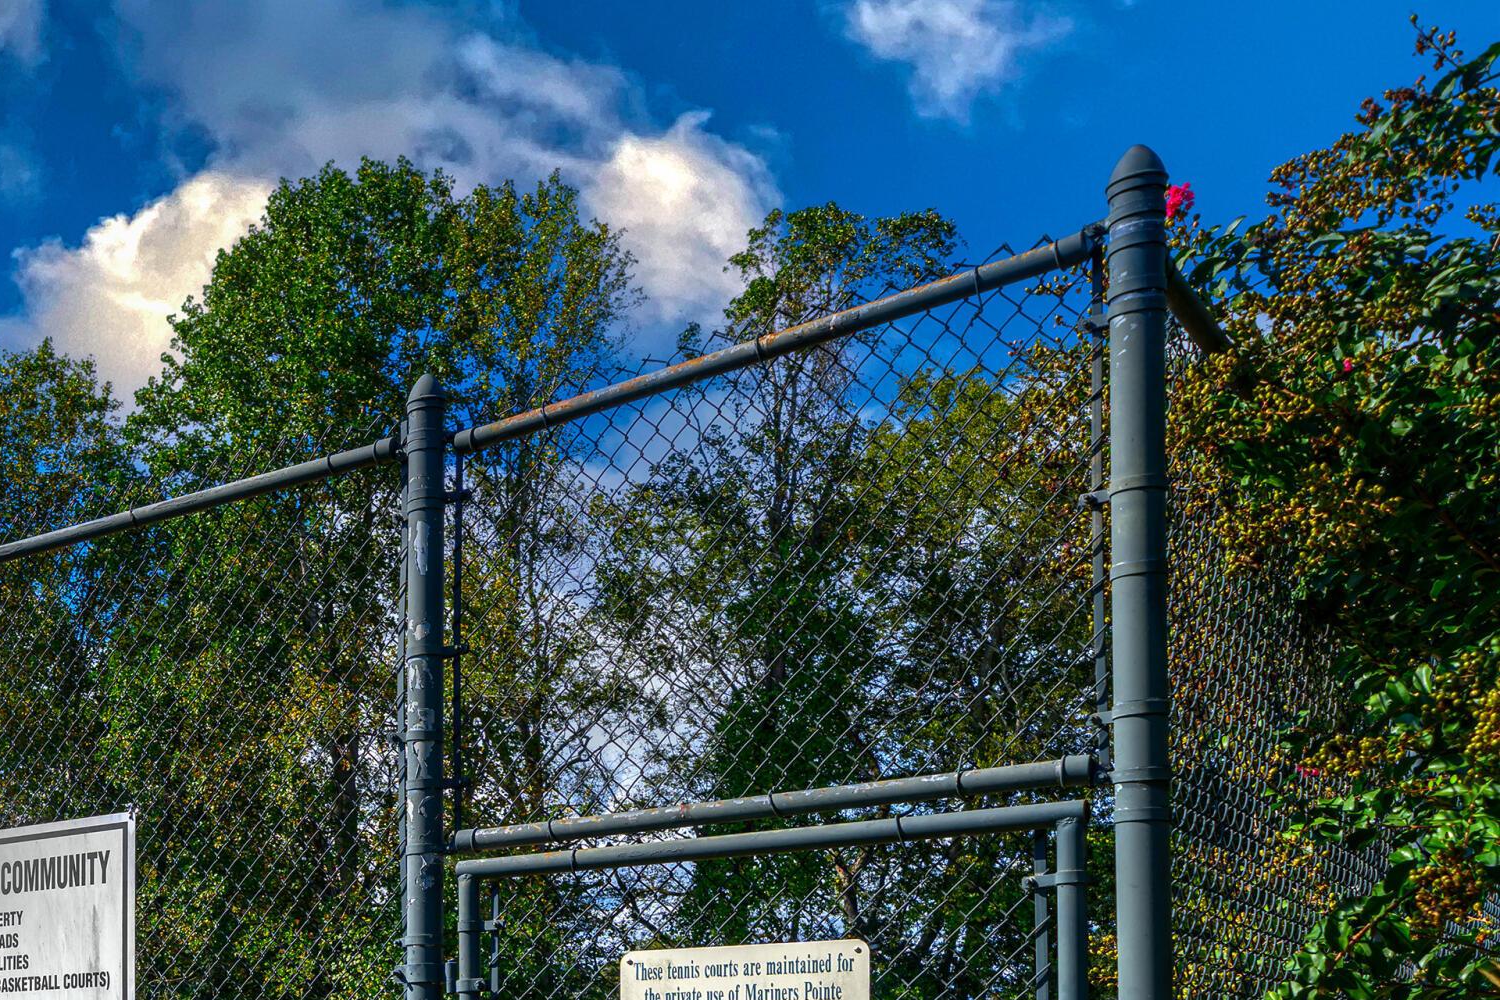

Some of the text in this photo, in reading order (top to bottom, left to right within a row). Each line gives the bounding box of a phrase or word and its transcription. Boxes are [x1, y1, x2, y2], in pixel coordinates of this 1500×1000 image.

[0, 849, 111, 896] COMMUNITY
[633, 952, 855, 982] These tennis courts are maintained for
[63, 970, 111, 991] COURTS)
[804, 980, 843, 1000] Pointe
